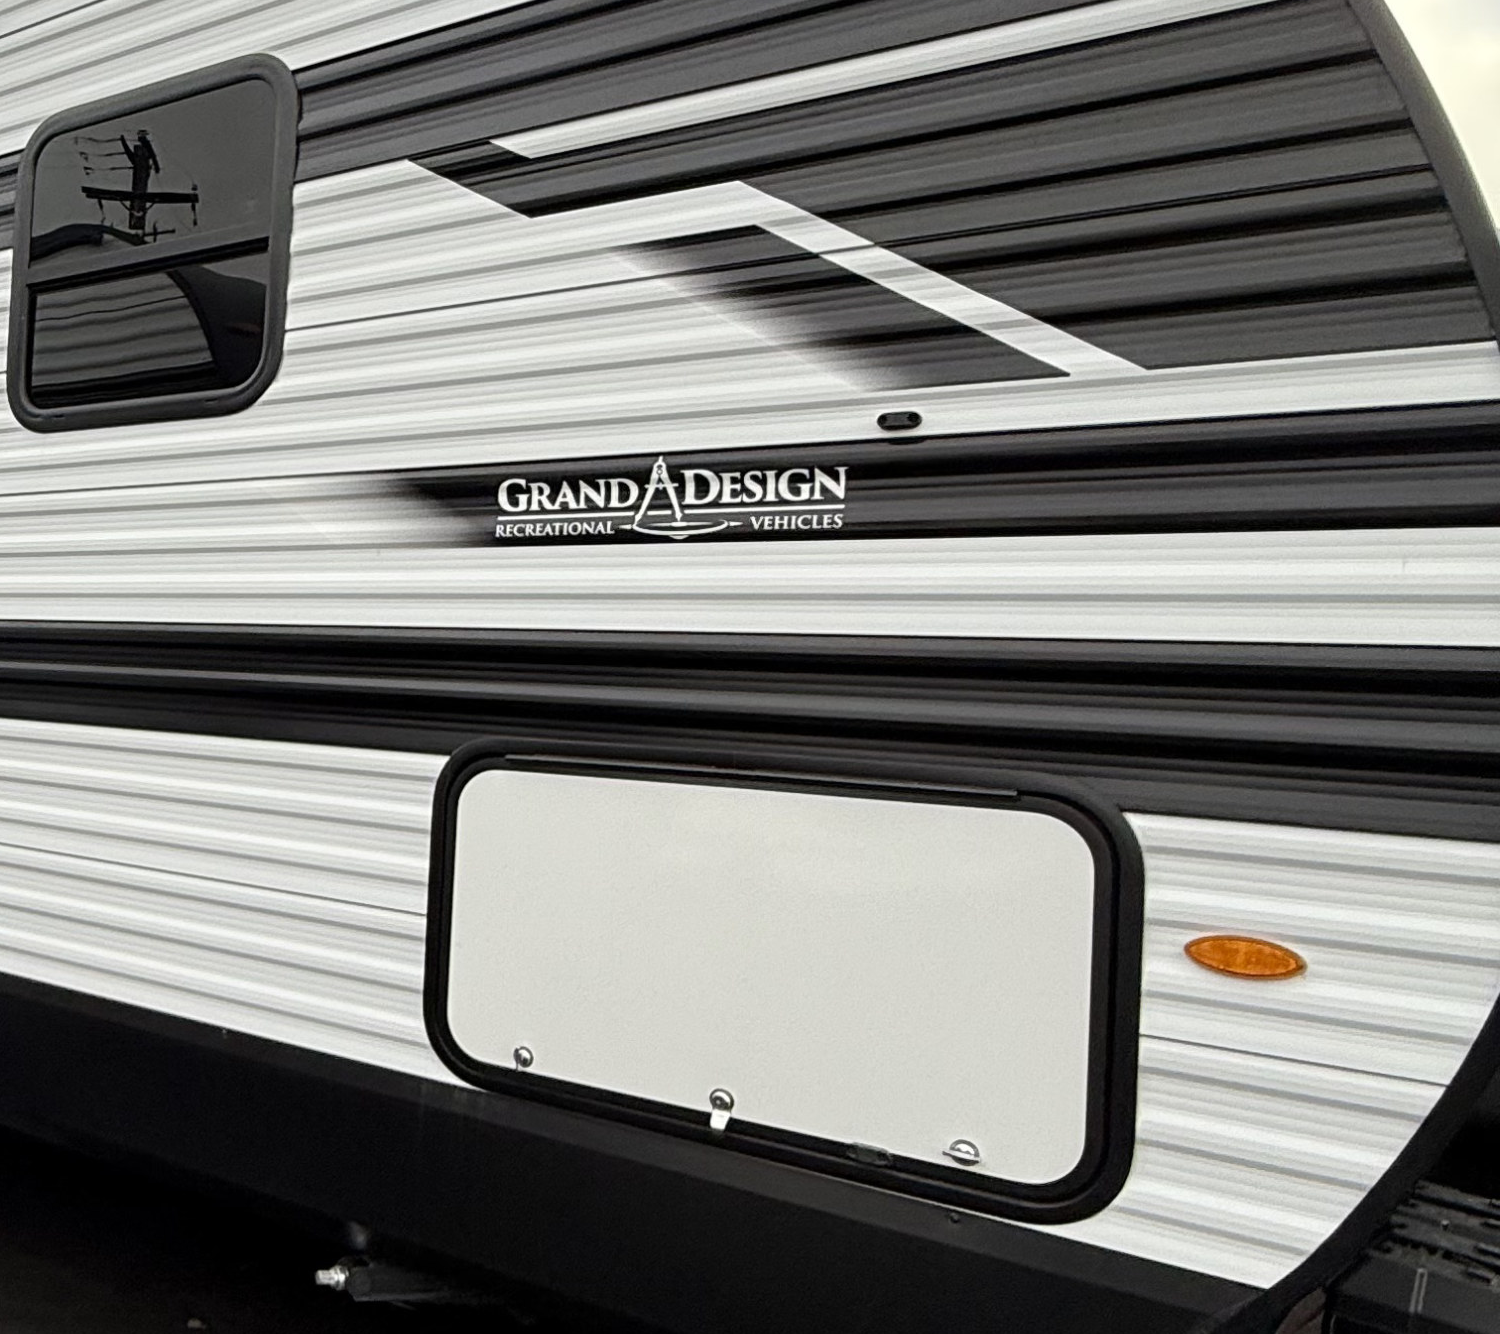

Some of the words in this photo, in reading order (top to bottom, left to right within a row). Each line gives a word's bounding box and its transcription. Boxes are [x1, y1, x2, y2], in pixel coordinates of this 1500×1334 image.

[497, 478, 638, 513] GRAND
[680, 466, 848, 506] DESIGN
[495, 520, 615, 538] RECREATIONAL
[749, 513, 843, 531] VEHICLES
